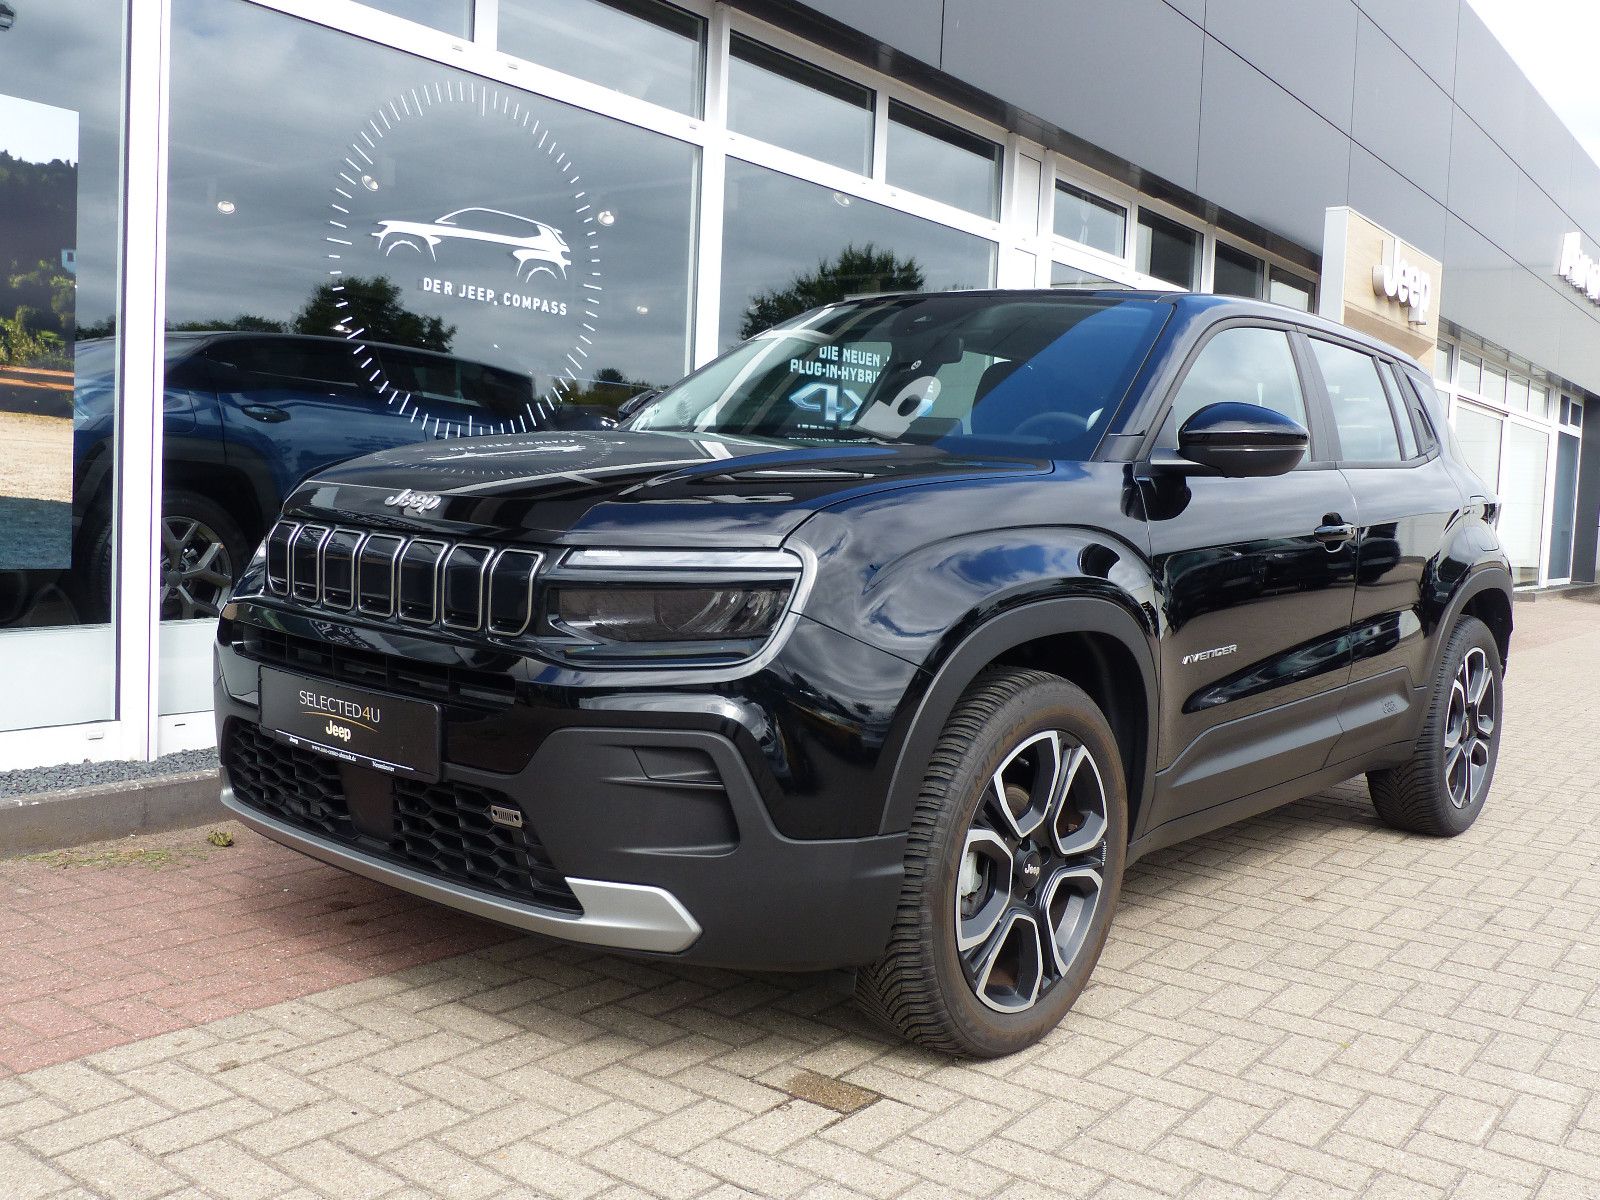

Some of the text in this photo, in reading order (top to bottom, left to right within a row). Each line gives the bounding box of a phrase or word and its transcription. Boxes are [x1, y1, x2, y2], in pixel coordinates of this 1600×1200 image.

[1372, 239, 1431, 325] Jeep
[423, 277, 453, 295] DER
[503, 292, 567, 316] COMPASS
[819, 346, 838, 360] DIE
[843, 348, 880, 367] NEUEN
[384, 488, 442, 513] Jeep
[1181, 644, 1237, 665] AVENGER
[299, 690, 380, 723] SELECTED4U
[325, 720, 351, 742] Jeep
[1024, 863, 1040, 875] Jeep
